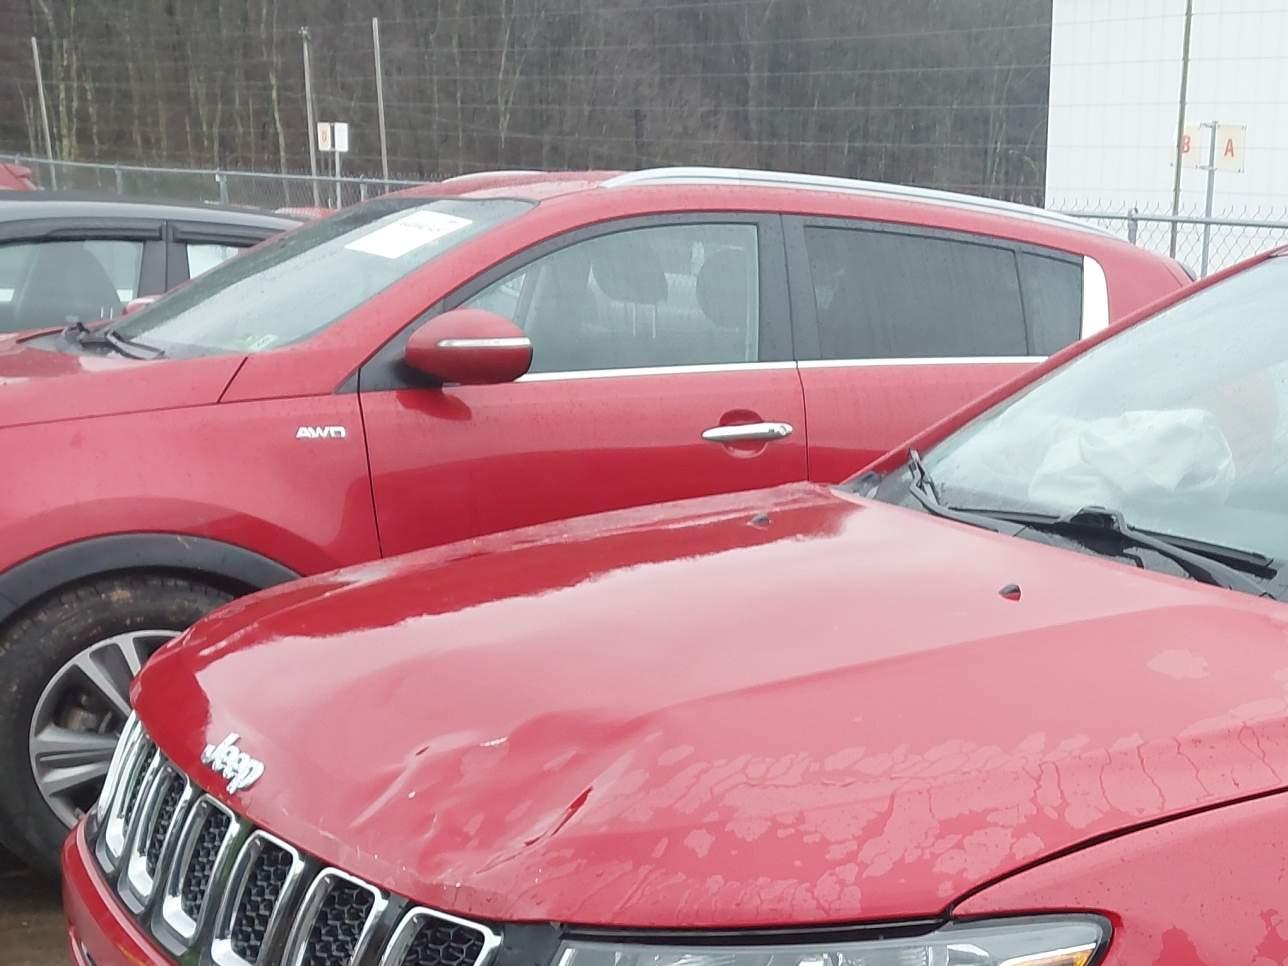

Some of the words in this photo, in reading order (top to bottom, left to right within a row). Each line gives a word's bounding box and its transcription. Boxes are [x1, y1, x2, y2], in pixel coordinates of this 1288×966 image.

[1179, 135, 1192, 154] B
[1223, 137, 1235, 158] A
[295, 426, 347, 439] AWD
[201, 732, 265, 795] Jeep
